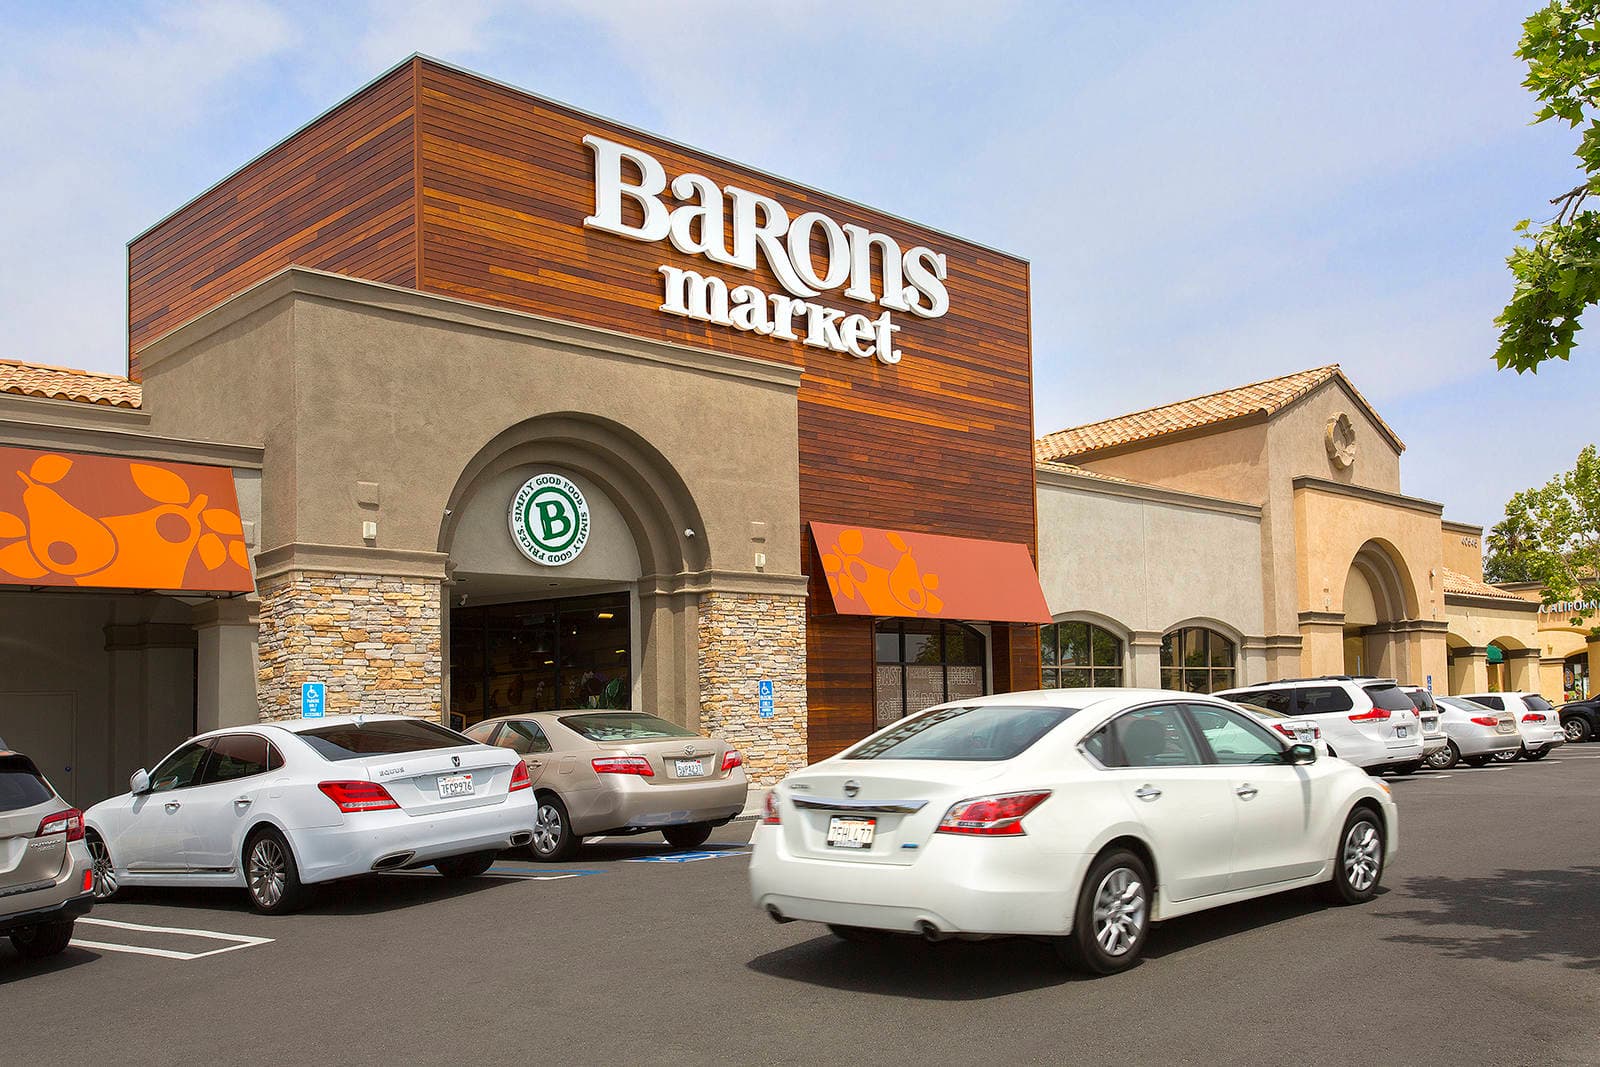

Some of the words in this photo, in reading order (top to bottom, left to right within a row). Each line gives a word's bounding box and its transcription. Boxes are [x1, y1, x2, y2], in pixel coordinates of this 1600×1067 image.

[658, 264, 901, 364] market
[515, 482, 534, 522] SIMPLY
[536, 477, 561, 486] GOOD
[535, 500, 571, 540] B
[573, 512, 588, 552] SIMPLY
[548, 551, 573, 562] GOOD
[440, 781, 472, 795] 7FCP976
